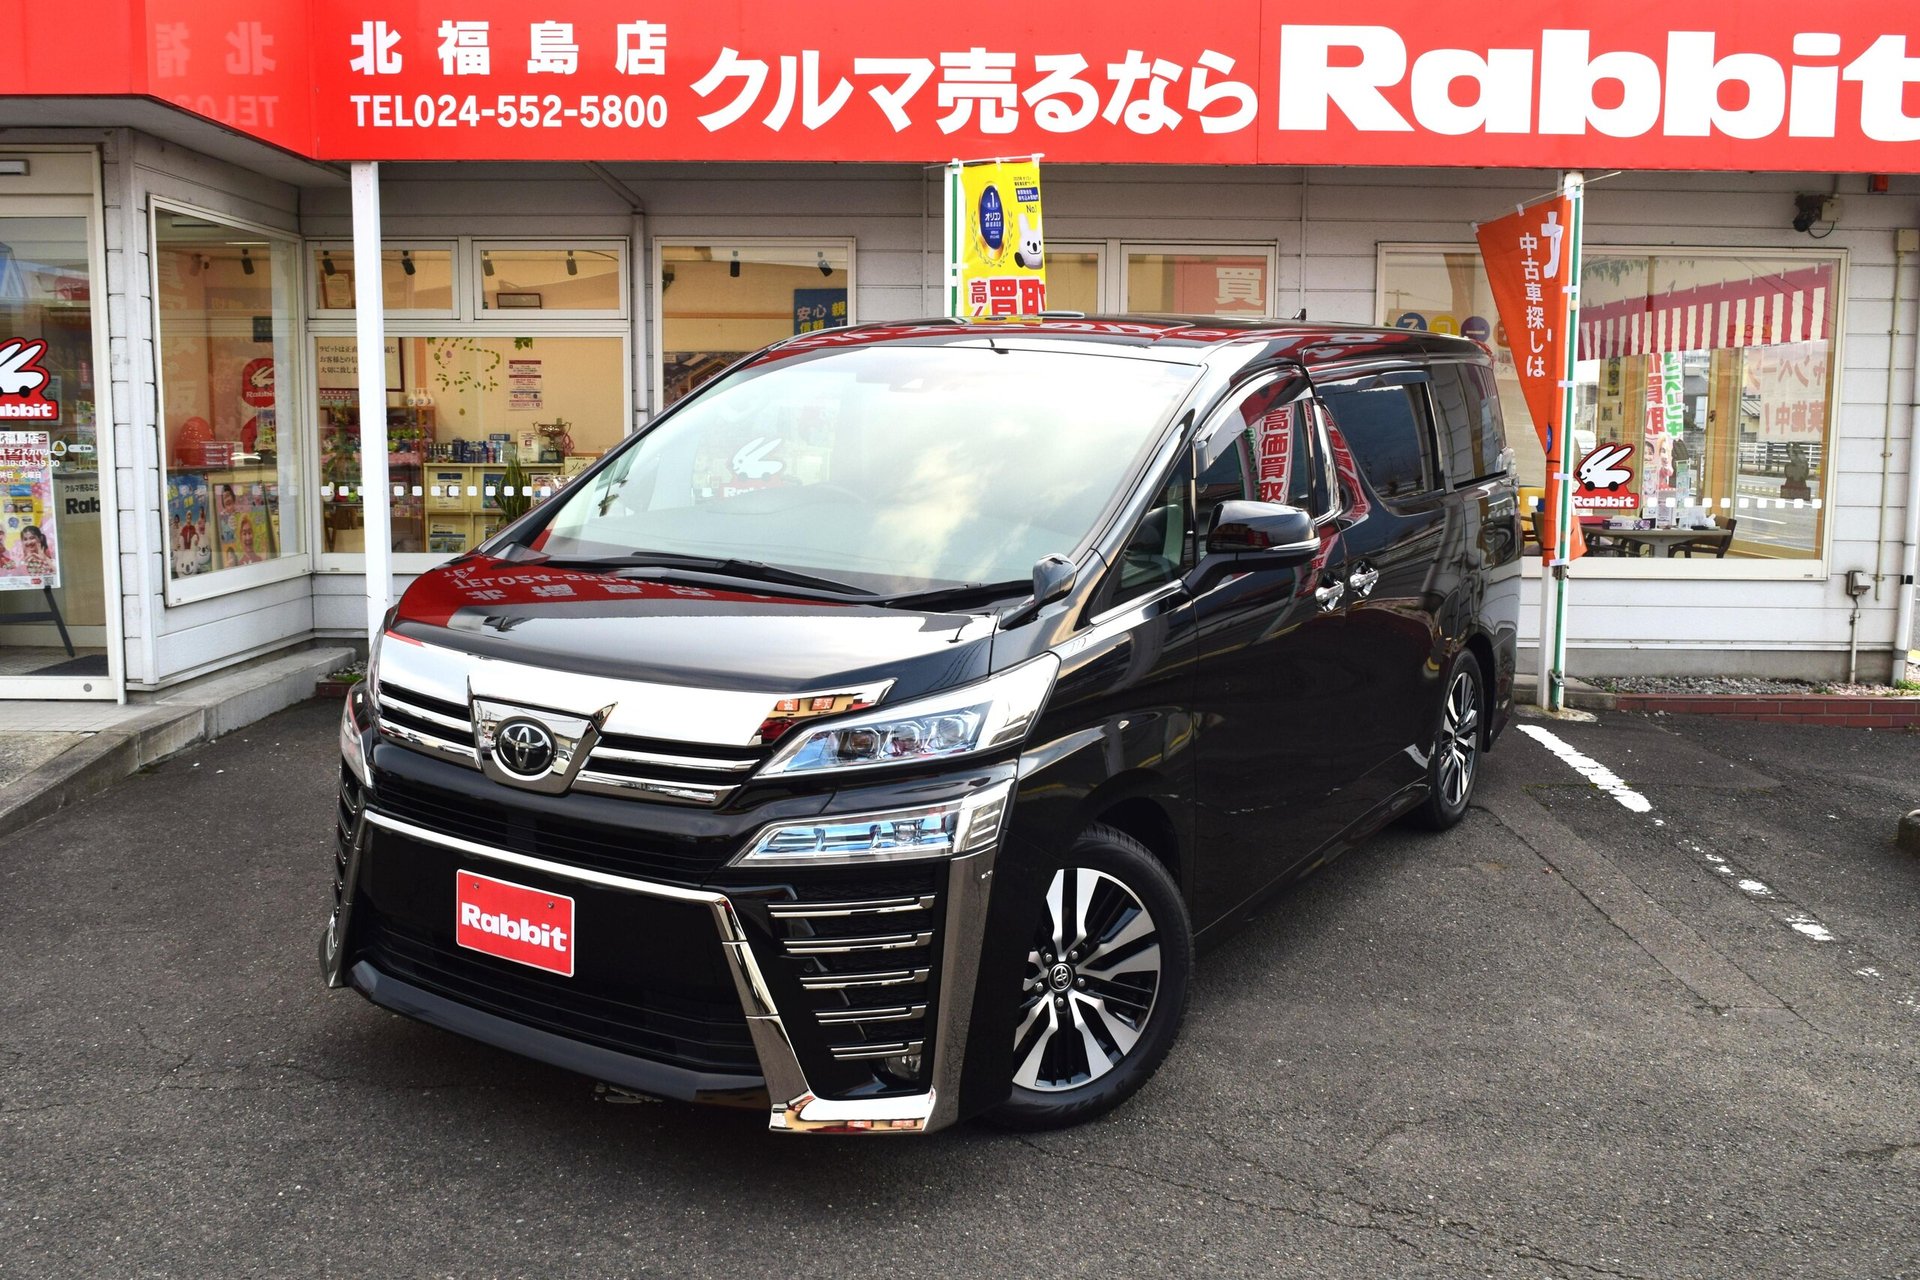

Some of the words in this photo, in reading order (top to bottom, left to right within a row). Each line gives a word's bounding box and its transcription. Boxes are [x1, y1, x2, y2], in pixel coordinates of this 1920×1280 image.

[350, 20, 667, 76] 北福島店
[351, 94, 668, 128] TEL024-552-5800
[690, 46, 1258, 134] クルマ売るなら
[1278, 24, 1920, 142] Rabbit
[1519, 232, 1546, 378] 中古車探しは
[1573, 495, 1634, 508] Rabbit
[461, 902, 567, 952] Rabbit
